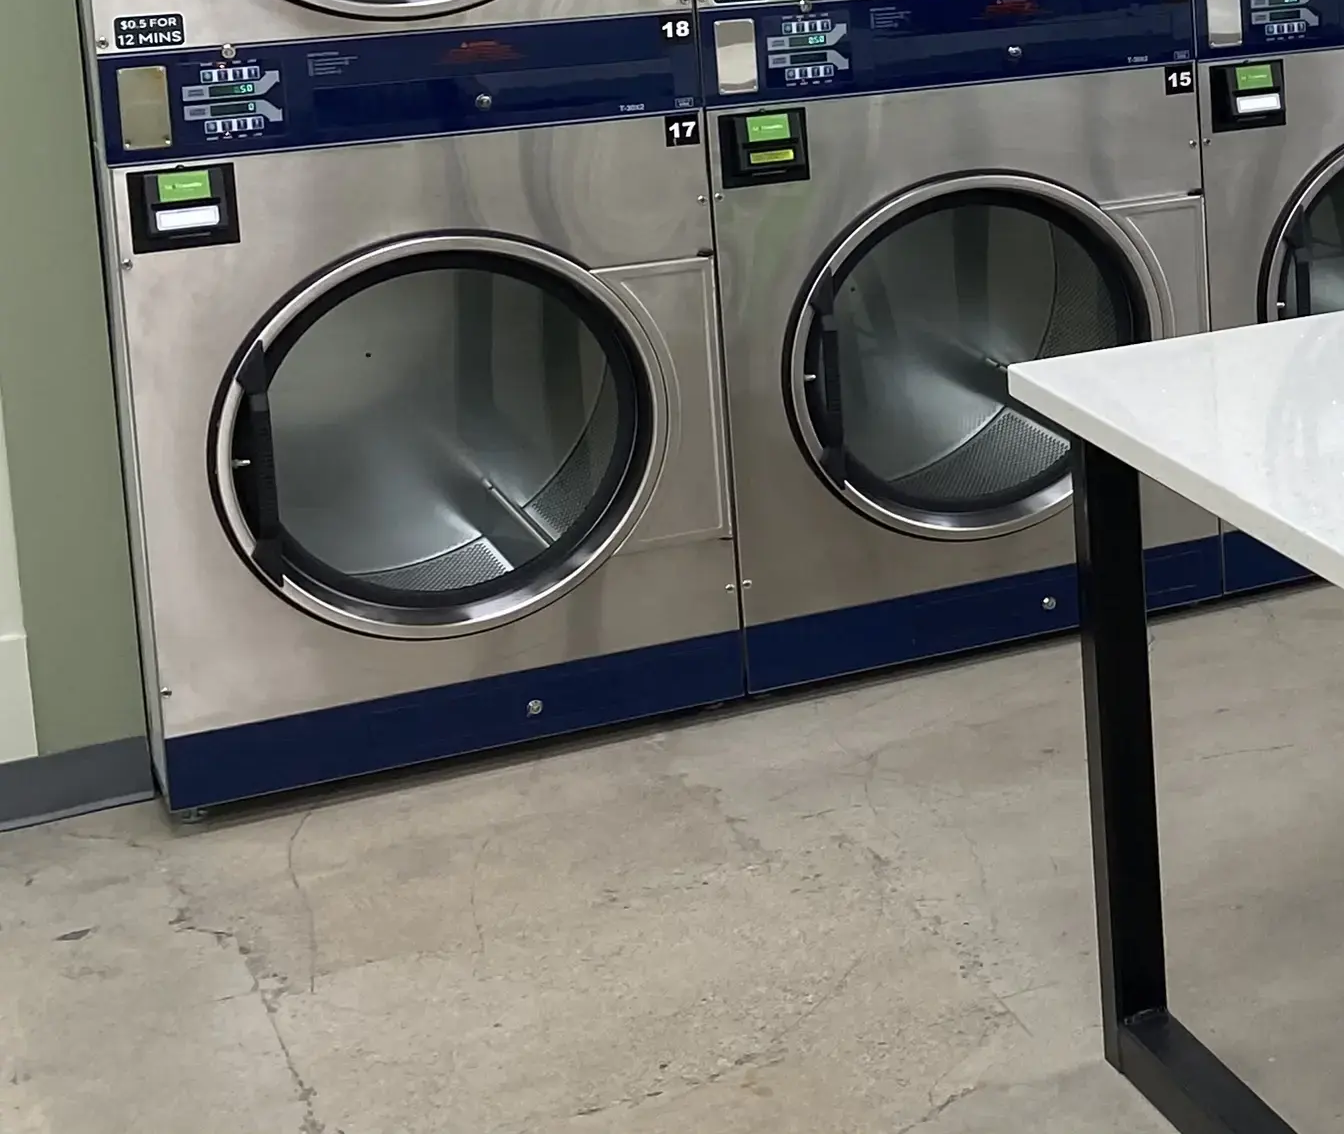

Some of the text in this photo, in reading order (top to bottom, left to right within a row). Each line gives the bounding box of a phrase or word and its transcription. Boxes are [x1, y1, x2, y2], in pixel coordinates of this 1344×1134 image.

[120, 16, 177, 31] $0.5 FOR
[661, 20, 690, 38] 18
[117, 30, 182, 46] 12 MINS
[1167, 71, 1191, 88] 15
[668, 121, 696, 140] 17
